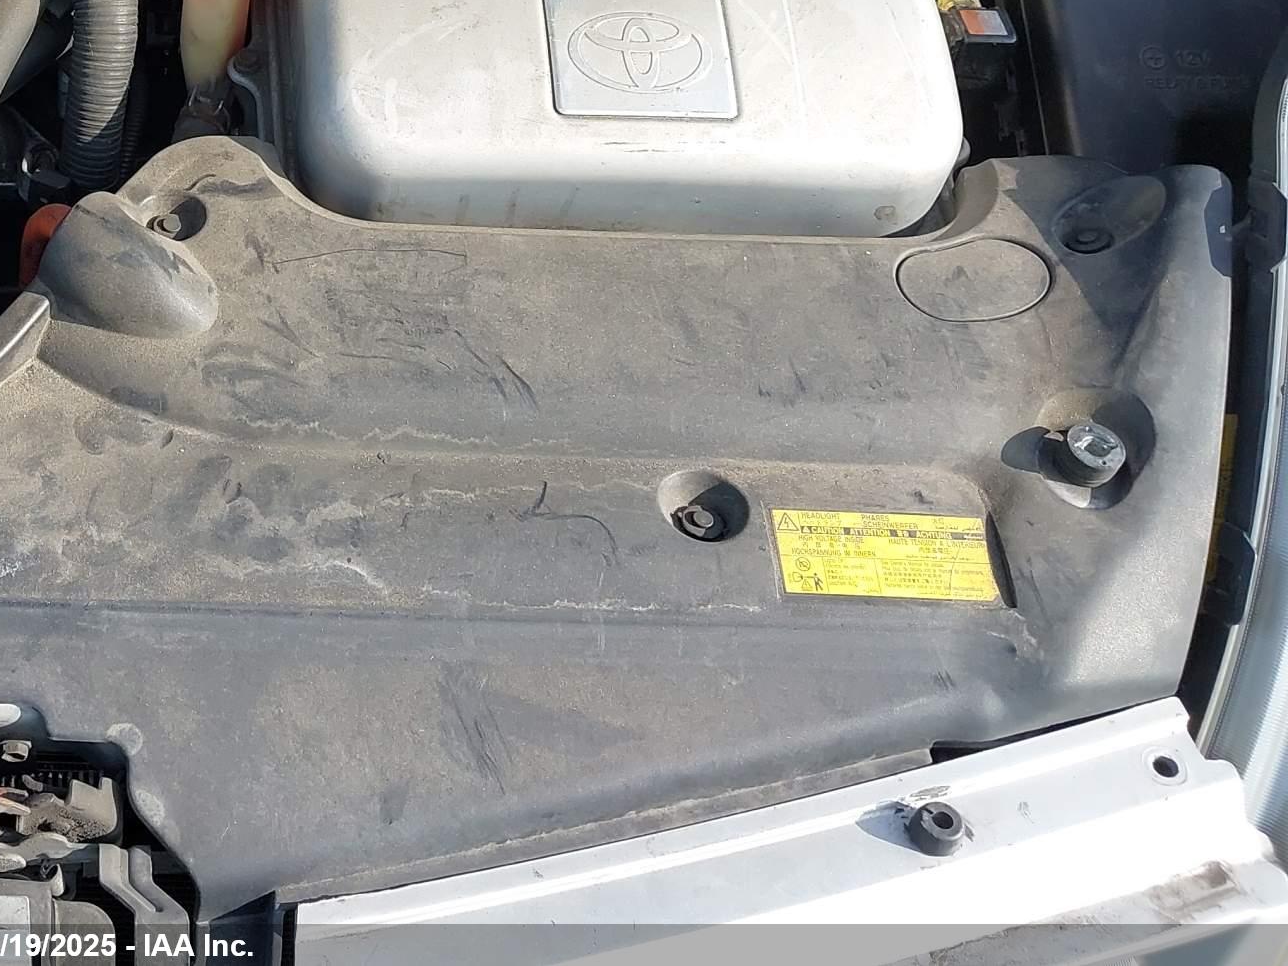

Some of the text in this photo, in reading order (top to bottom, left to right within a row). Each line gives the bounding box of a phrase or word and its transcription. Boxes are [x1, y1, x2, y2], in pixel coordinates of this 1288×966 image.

[800, 512, 890, 522] HEADLIGHT PHARES
[811, 525, 844, 534] CAUTION
[850, 527, 891, 537] ATTENTION
[916, 532, 953, 540] ACHTUNG
